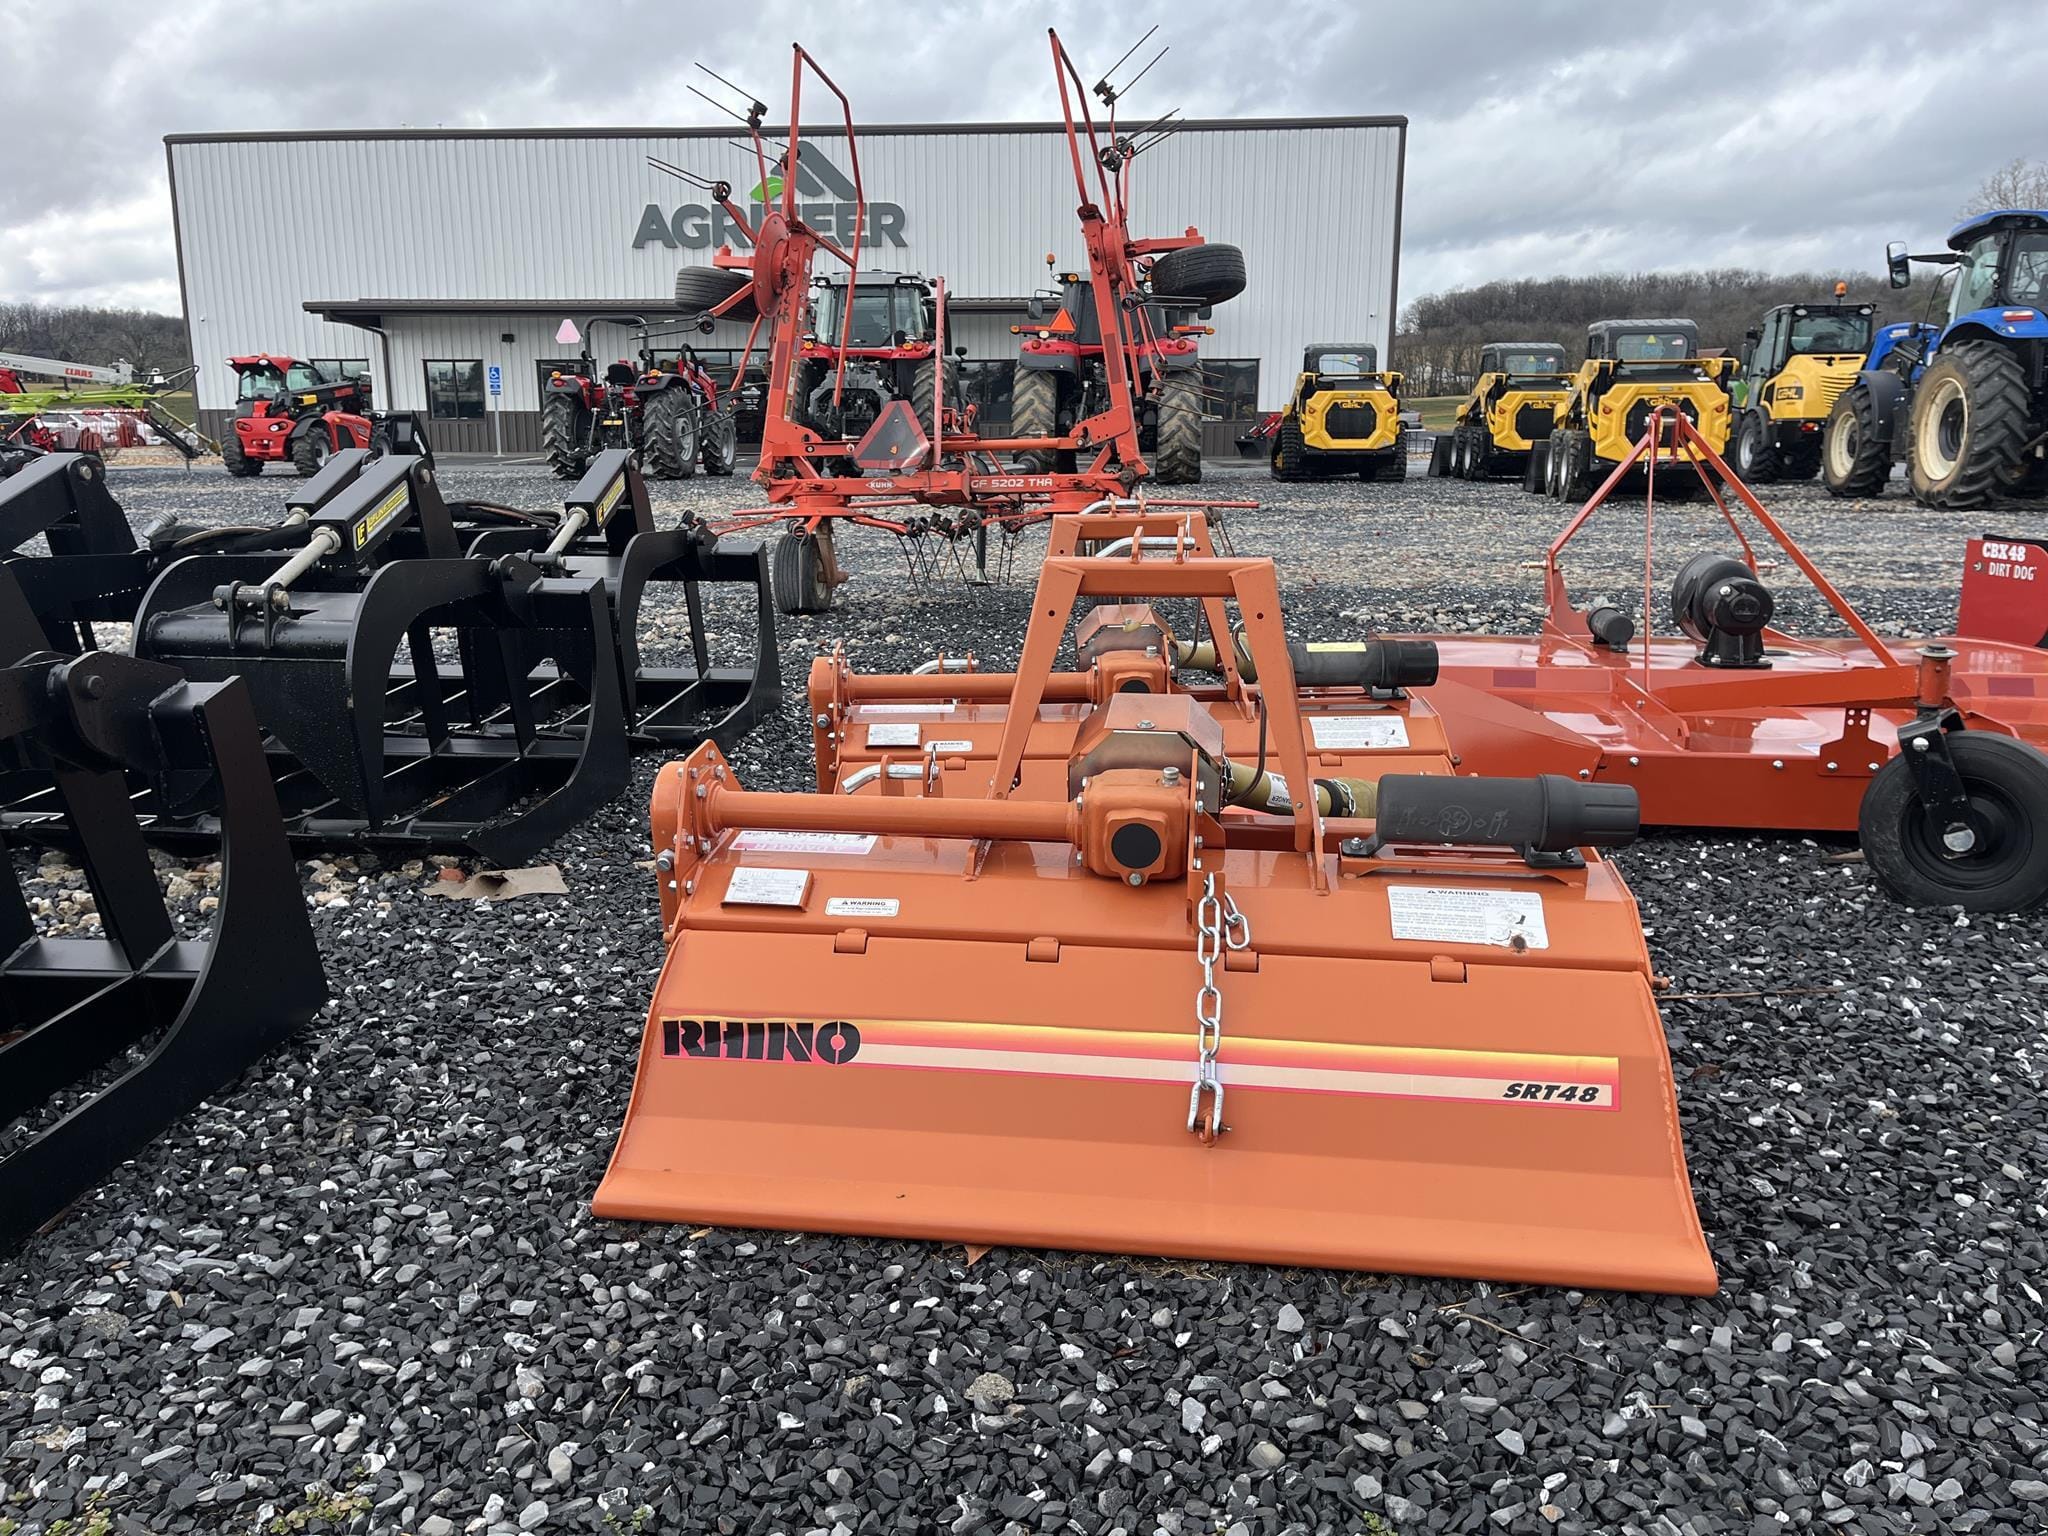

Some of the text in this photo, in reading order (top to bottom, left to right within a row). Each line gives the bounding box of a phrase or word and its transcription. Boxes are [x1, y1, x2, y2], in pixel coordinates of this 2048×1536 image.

[65, 368, 94, 378] CLAAS
[971, 478, 1053, 488] GF 5202 THA
[1982, 541, 2026, 562] CBX48
[1988, 561, 2034, 580] DIRT DOG
[662, 1019, 861, 1065] RHINO
[1502, 1082, 1600, 1102] SRT48
